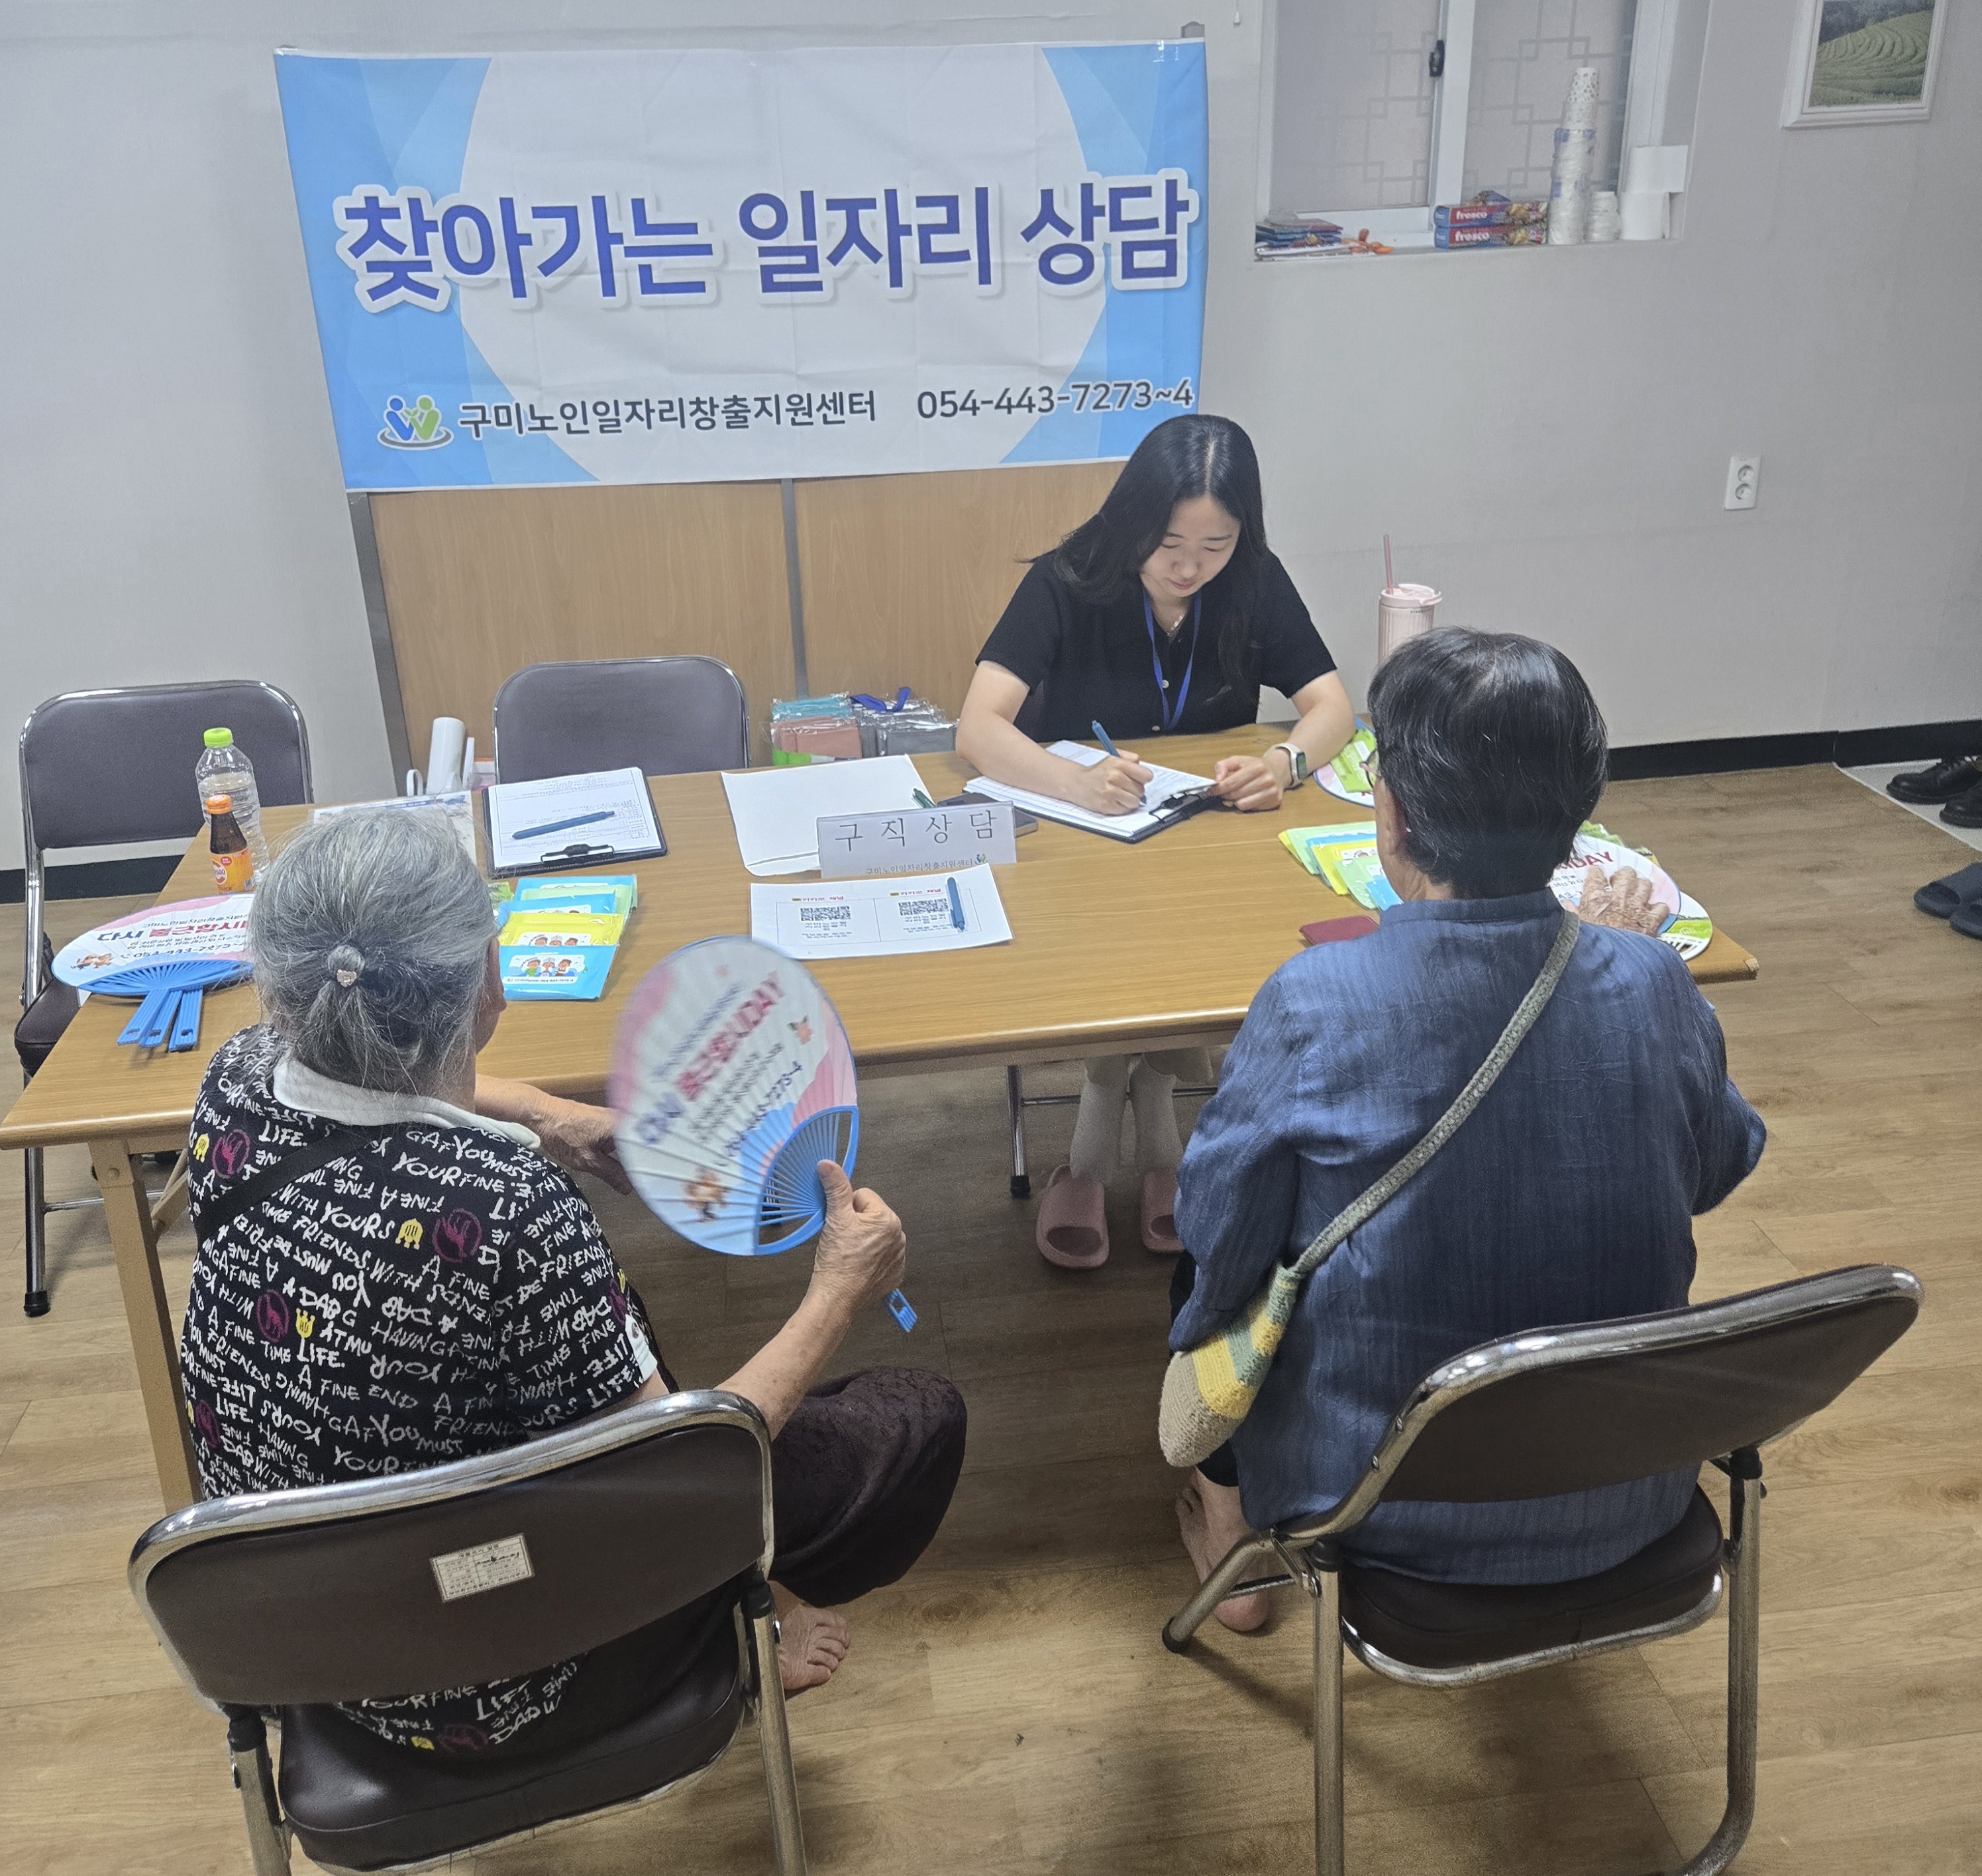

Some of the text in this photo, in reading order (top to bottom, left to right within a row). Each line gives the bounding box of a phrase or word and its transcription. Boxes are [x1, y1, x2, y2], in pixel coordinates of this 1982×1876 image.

[343, 179, 1190, 302] 찾아가는 일자리 상담
[459, 378, 1194, 440] 구미노인일자리창출지원센터 054-443-7273~4
[258, 1120, 308, 1147] LIFE.
[391, 1151, 463, 1187] YOUR
[458, 1172, 505, 1194] FINE
[333, 1178, 376, 1200] FINE
[401, 1192, 445, 1214] FINE
[279, 1182, 395, 1239] WITH YOURS
[332, 1269, 372, 1308] YOU
[295, 1338, 346, 1369] LIFE.
[369, 1354, 443, 1384] YOUR
[320, 1378, 361, 1401] FINE
[215, 1392, 254, 1424] LIFE.
[260, 1399, 321, 1447] YOURS
